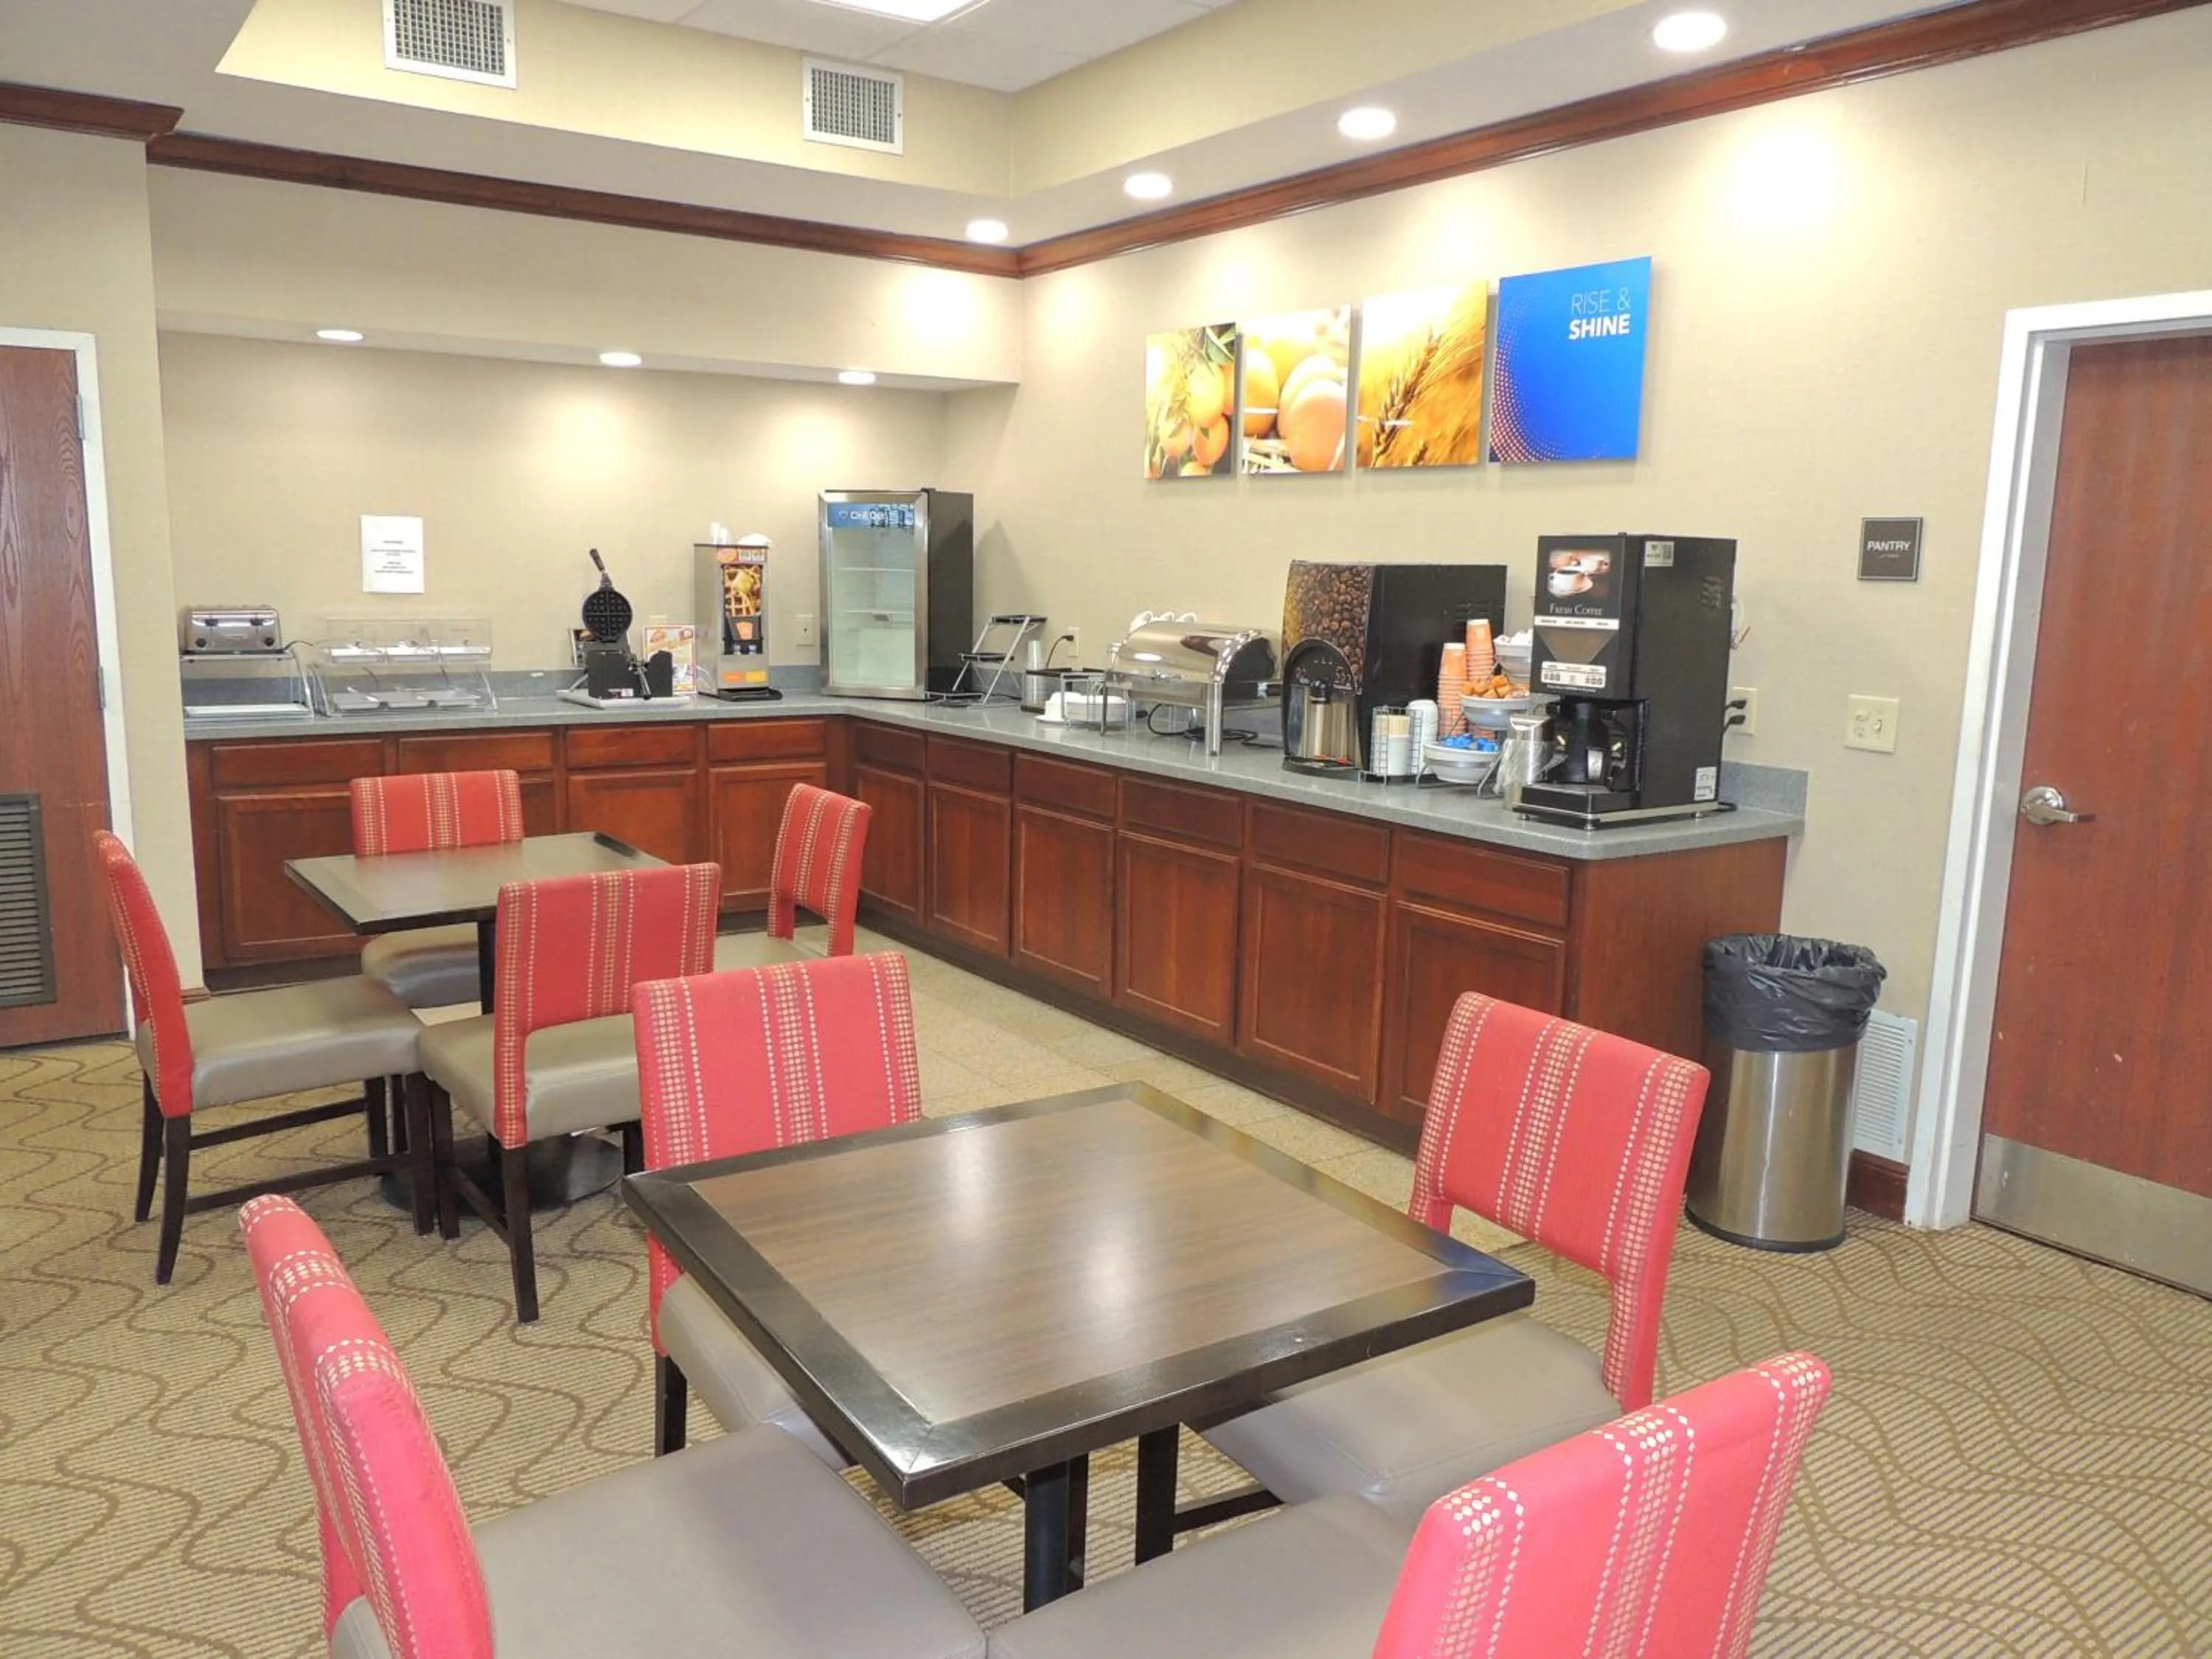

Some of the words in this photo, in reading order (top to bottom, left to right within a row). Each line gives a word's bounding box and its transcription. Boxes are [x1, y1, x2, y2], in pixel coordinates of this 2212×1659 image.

[1571, 289, 1611, 316] RISE
[1617, 286, 1632, 311] &
[1568, 313, 1632, 341] SHINE
[1866, 540, 1912, 552] PANTRY
